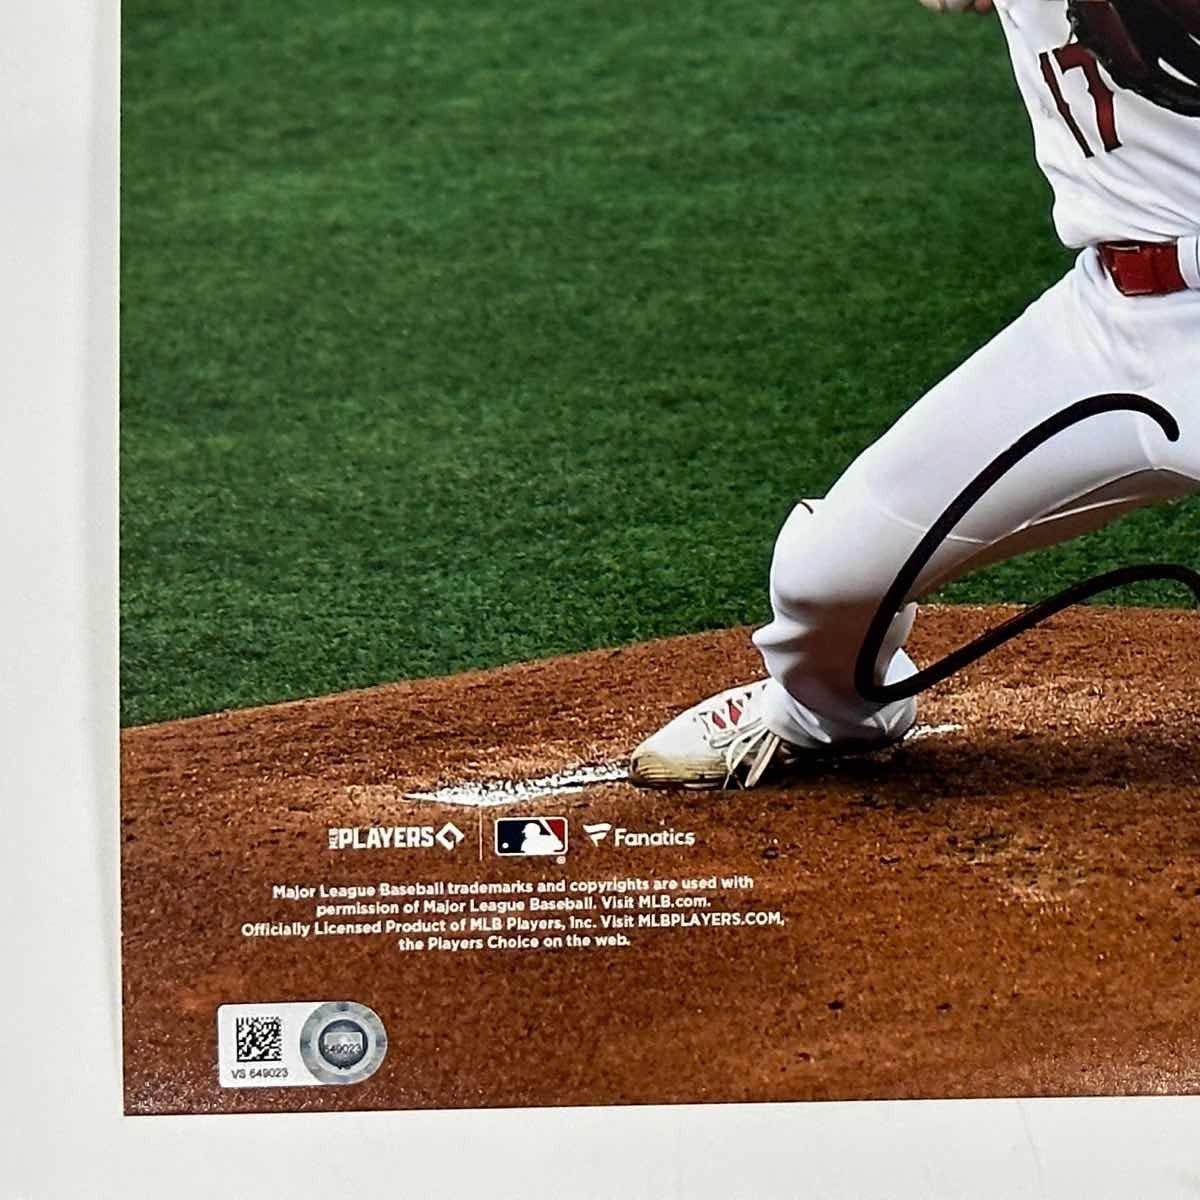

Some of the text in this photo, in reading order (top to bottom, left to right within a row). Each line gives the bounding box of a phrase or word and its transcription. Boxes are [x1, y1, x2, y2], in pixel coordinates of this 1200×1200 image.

[1038, 41, 1123, 159] 17
[338, 826, 435, 849] PLAYERS
[614, 826, 696, 847] Fanatics
[272, 874, 754, 901] Major League Baseball trademarks and copyrights are used with
[316, 894, 711, 918] permission of Major League Baseball. Visit MLB.com.
[241, 921, 311, 938] Officially
[314, 920, 382, 936] Licensed
[385, 918, 447, 934] Product
[449, 917, 467, 932] of
[469, 916, 503, 932] MLB
[506, 916, 566, 932] Players,
[569, 915, 597, 929] Inc.
[599, 914, 635, 929] Visit
[397, 932, 631, 952] the Players Choice on the web.
[231, 1066, 289, 1080] VS 649023
